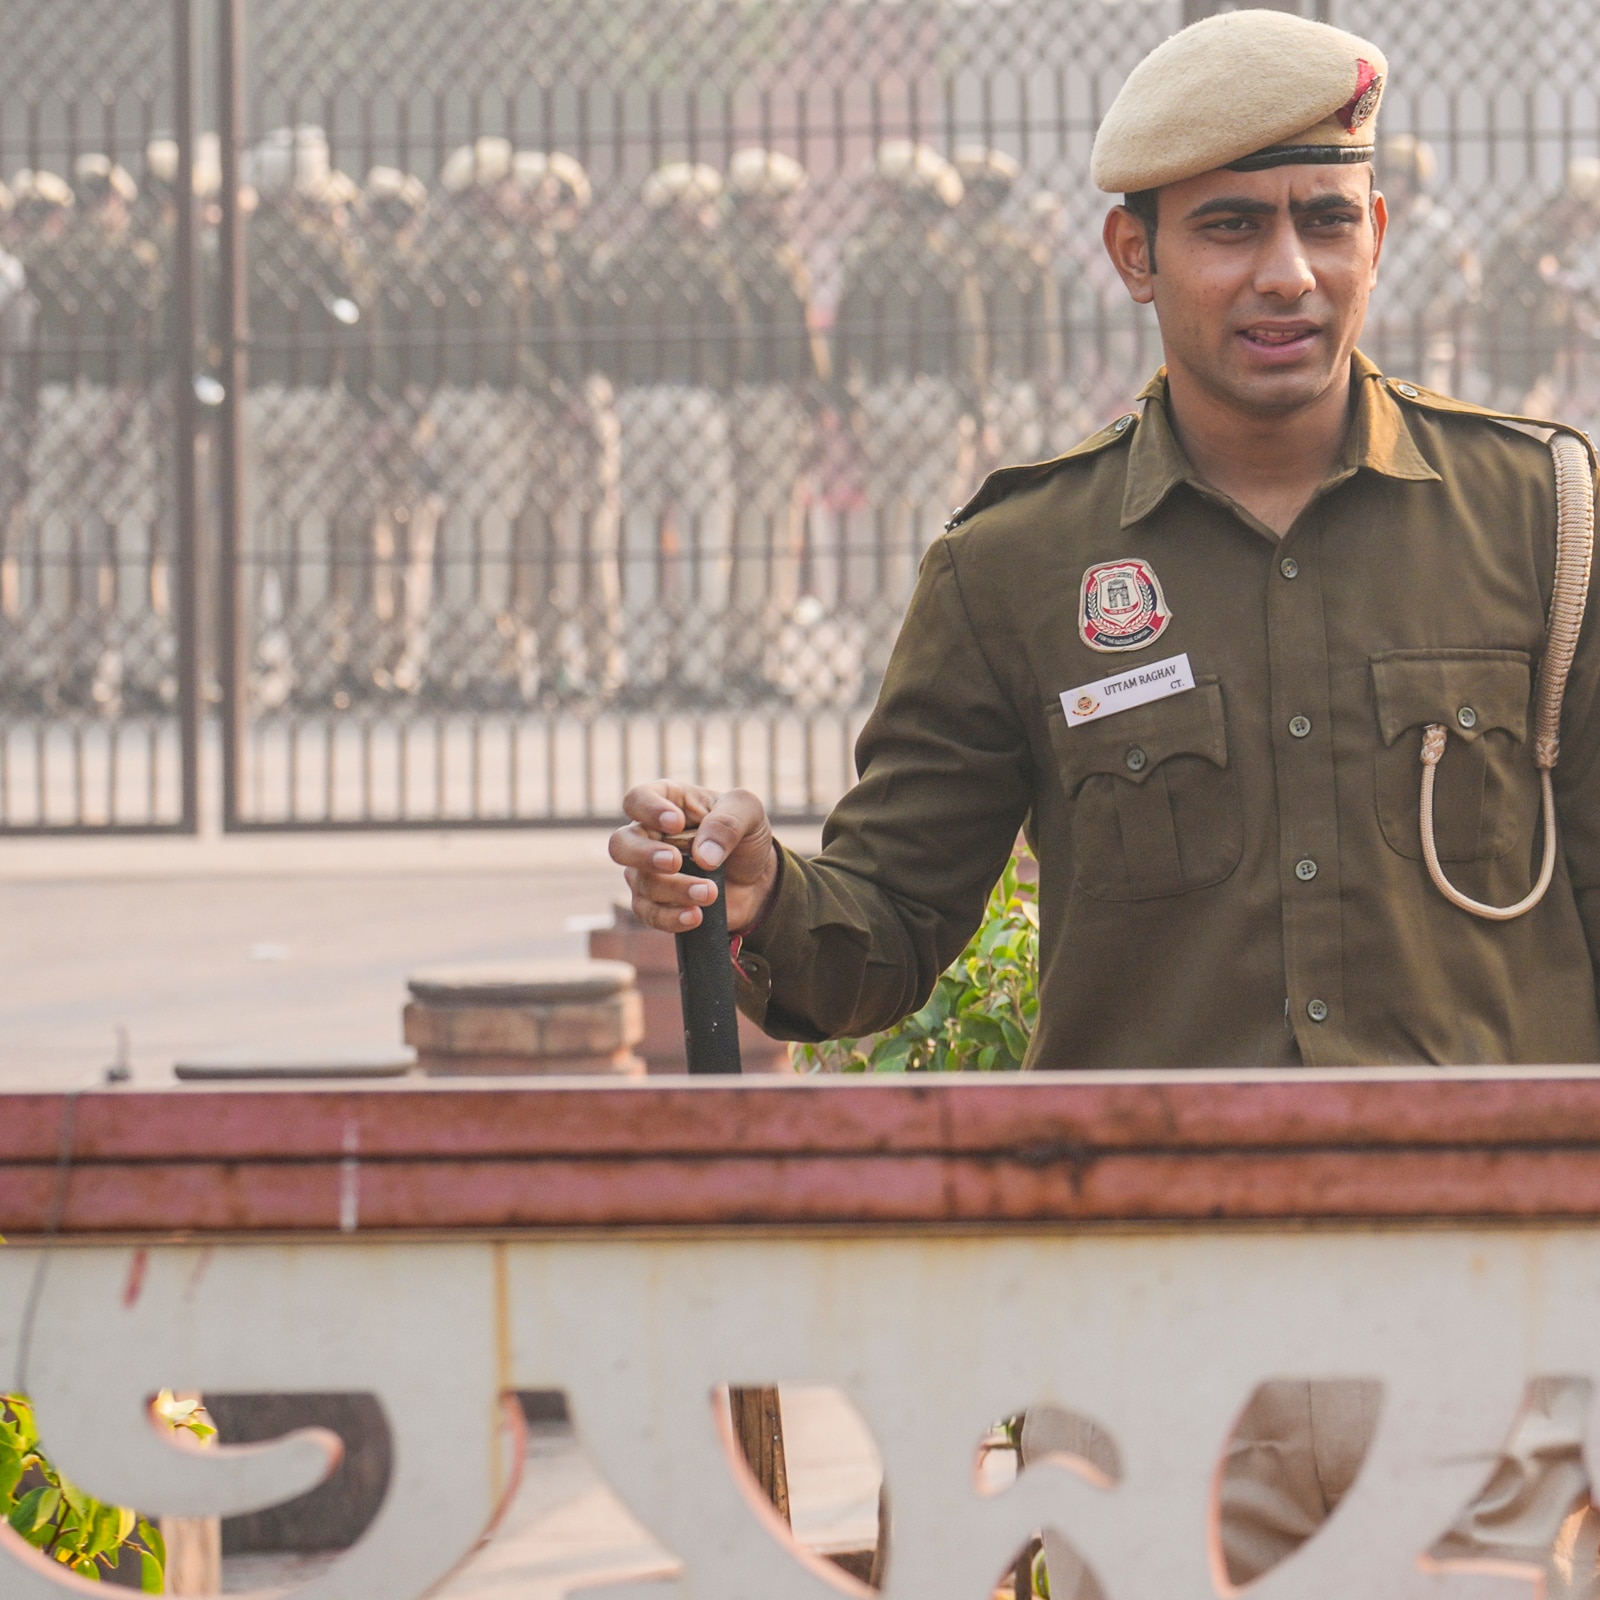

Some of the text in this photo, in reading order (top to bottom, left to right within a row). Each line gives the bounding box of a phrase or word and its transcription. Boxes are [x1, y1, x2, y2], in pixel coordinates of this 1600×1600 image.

[1104, 665, 1176, 696] UTTAM RAGHAV
[1170, 679, 1184, 690] CT.
